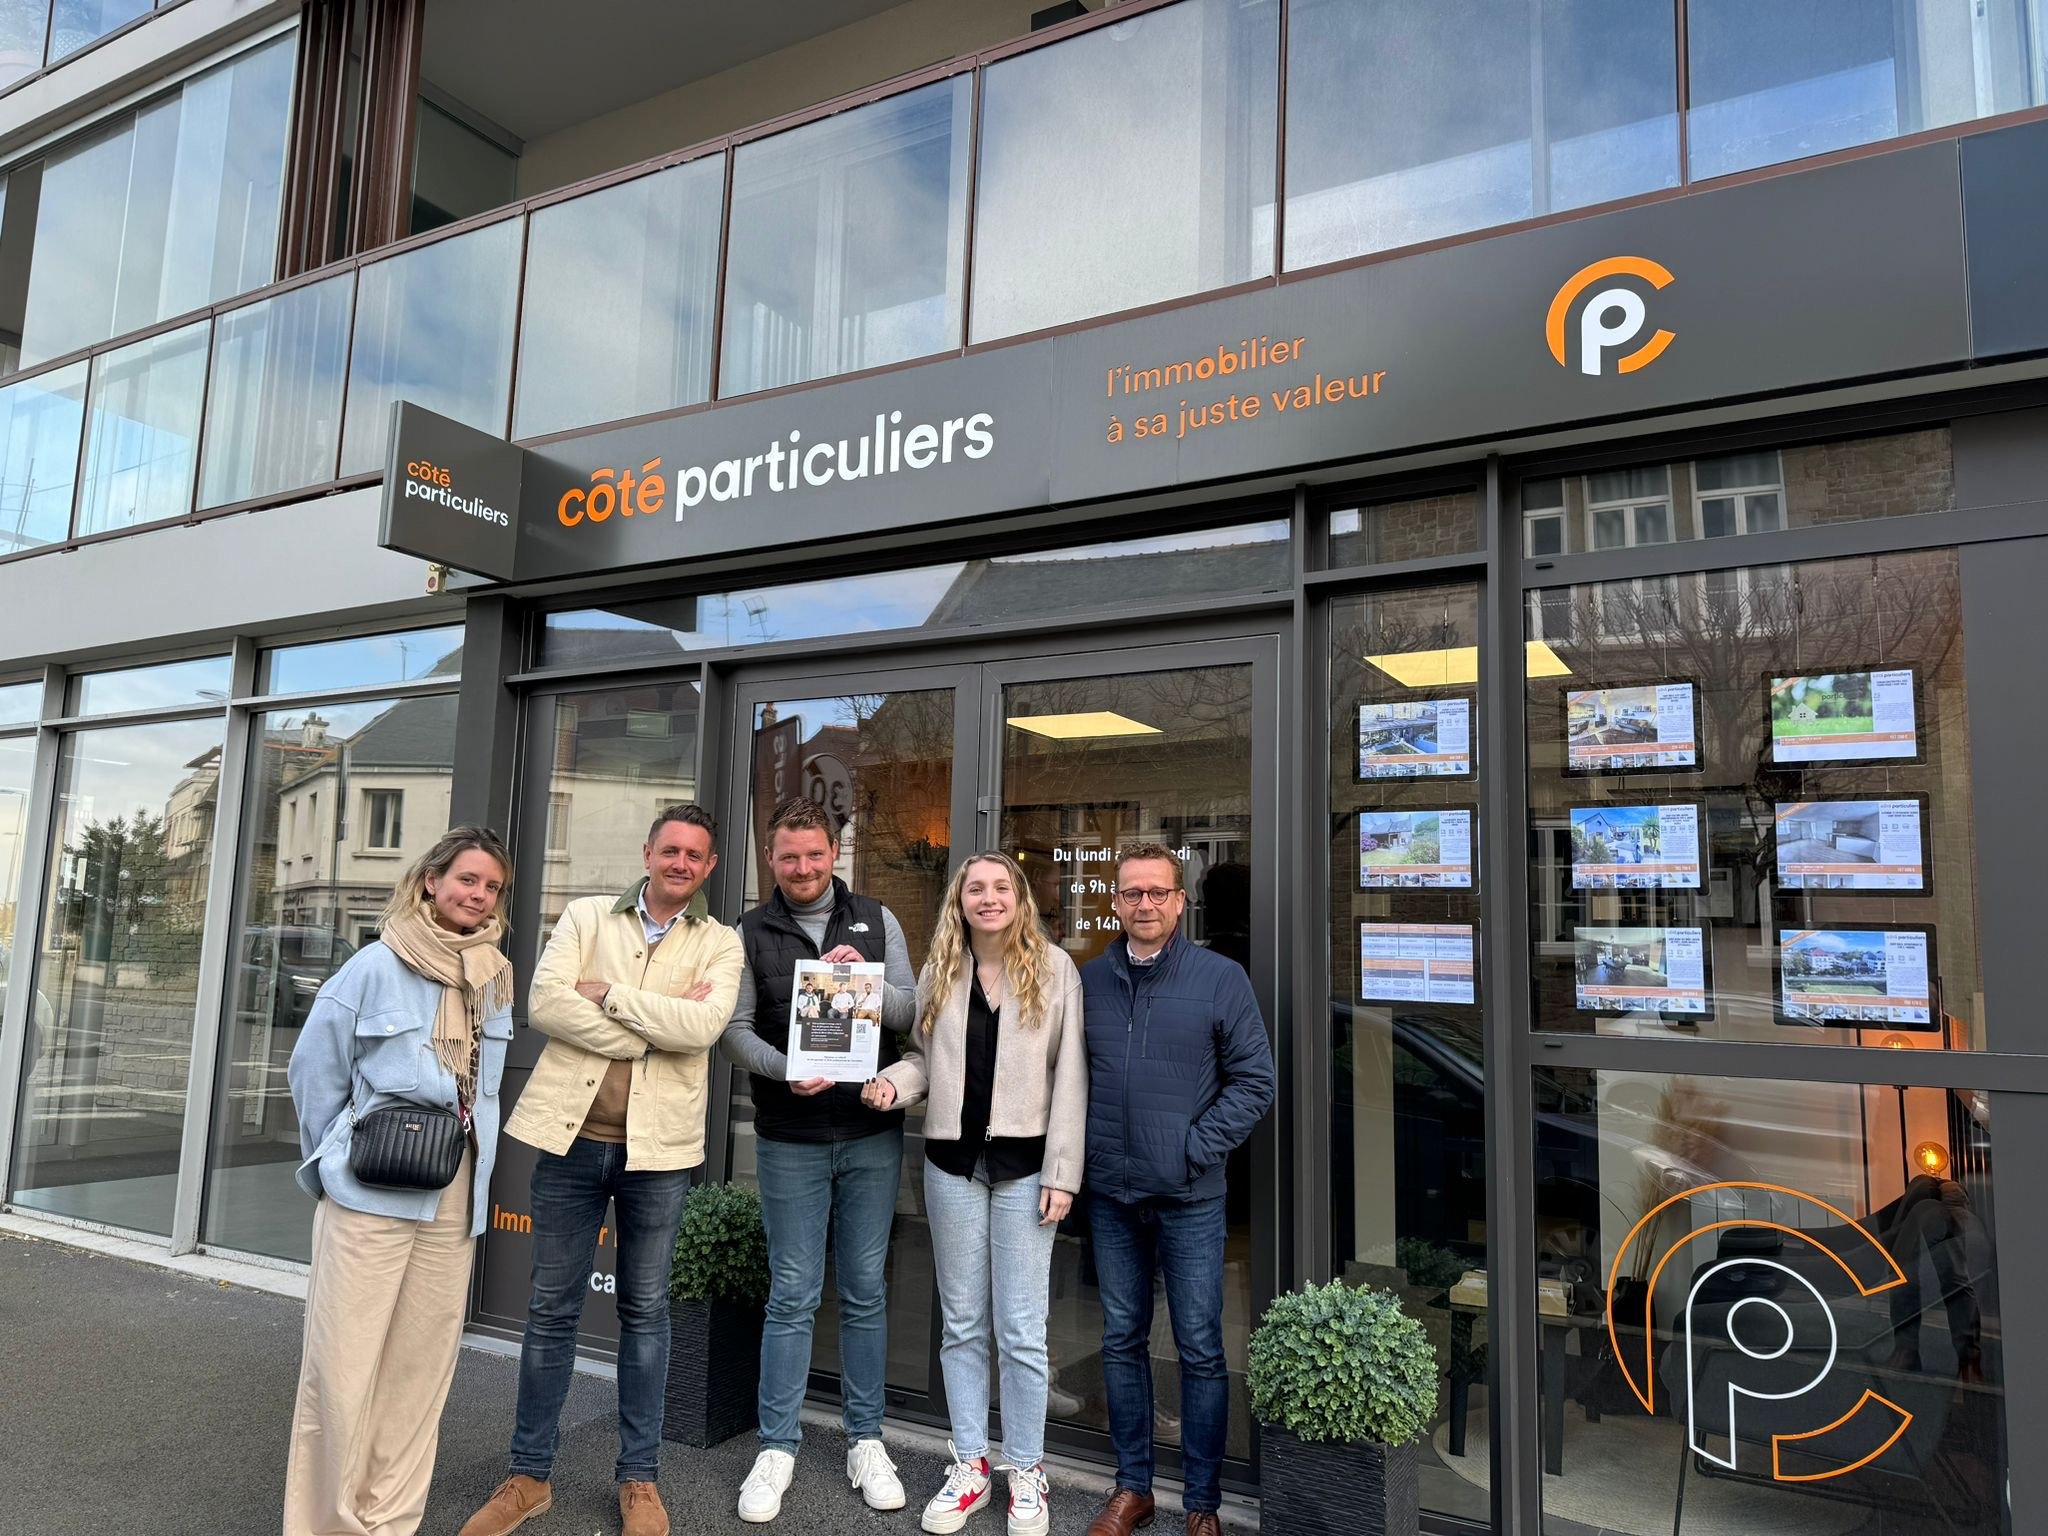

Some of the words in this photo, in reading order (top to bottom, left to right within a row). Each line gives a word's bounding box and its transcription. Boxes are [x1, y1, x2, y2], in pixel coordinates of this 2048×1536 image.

[1106, 415, 1123, 443] à
[1133, 412, 1167, 439] sa
[1175, 399, 1260, 438] juste
[1272, 370, 1387, 412] valeur
[675, 410, 994, 522] particuliers
[405, 479, 509, 527] particuliers
[1053, 848, 1072, 862] Du
[1075, 847, 1111, 862] lundi
[1070, 880, 1086, 894] de
[1089, 879, 1106, 894] 9h
[1075, 917, 1091, 930] de
[1095, 916, 1120, 931] 14h
